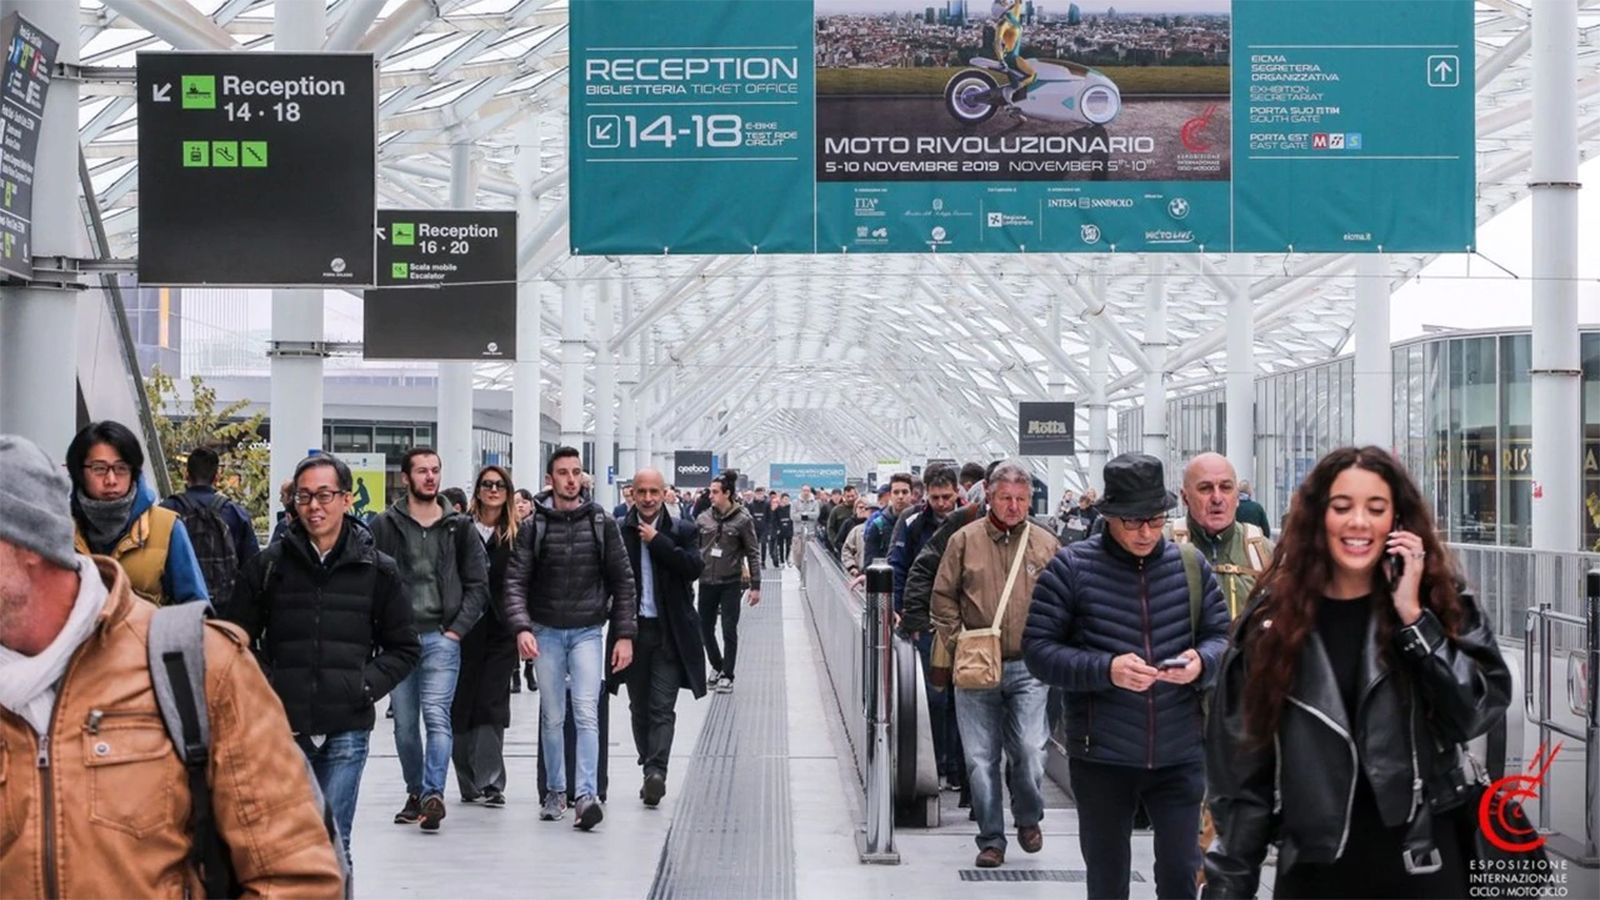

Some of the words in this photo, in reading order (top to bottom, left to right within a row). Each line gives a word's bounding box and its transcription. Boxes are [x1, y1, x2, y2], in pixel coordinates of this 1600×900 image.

[1251, 55, 1287, 63] EICMA
[586, 57, 798, 81] RECEPTION
[1251, 64, 1321, 72] SEGRETERIA
[1251, 73, 1340, 81] ORGANIZZATIVA
[223, 75, 345, 99] Reception
[586, 84, 687, 95] BIGLIETTERIA
[691, 84, 743, 95] TICKET
[745, 83, 798, 93] OFFICE
[1250, 85, 1309, 93] EXHIBITION
[1250, 93, 1324, 101] SECRETARIAT
[224, 102, 252, 121] 14
[273, 102, 300, 121] 18
[1250, 107, 1288, 115] PORTA
[1250, 115, 1289, 123] SOUTH
[1290, 115, 1321, 123] GATE
[745, 122, 778, 130] E-BIKE
[625, 114, 742, 148] 14-18
[774, 131, 798, 139] RIDE
[1250, 133, 1286, 141] PORTA
[1287, 133, 1309, 141] EST
[825, 137, 910, 154] MOTO
[917, 136, 1154, 153] RIVOLUZIONARIO
[825, 162, 860, 172] 5-10
[864, 161, 958, 172] NOVEMBRE
[962, 161, 1000, 171] 2019
[1009, 160, 1103, 171] NOVEMBER
[1048, 199, 1077, 208] INTESA
[419, 223, 498, 240] Reception
[420, 241, 438, 254] 16
[450, 241, 469, 254] 20
[410, 263, 430, 271] Scala
[432, 263, 457, 271] mobile
[410, 272, 445, 280] Escalator
[1027, 420, 1067, 434] Motta
